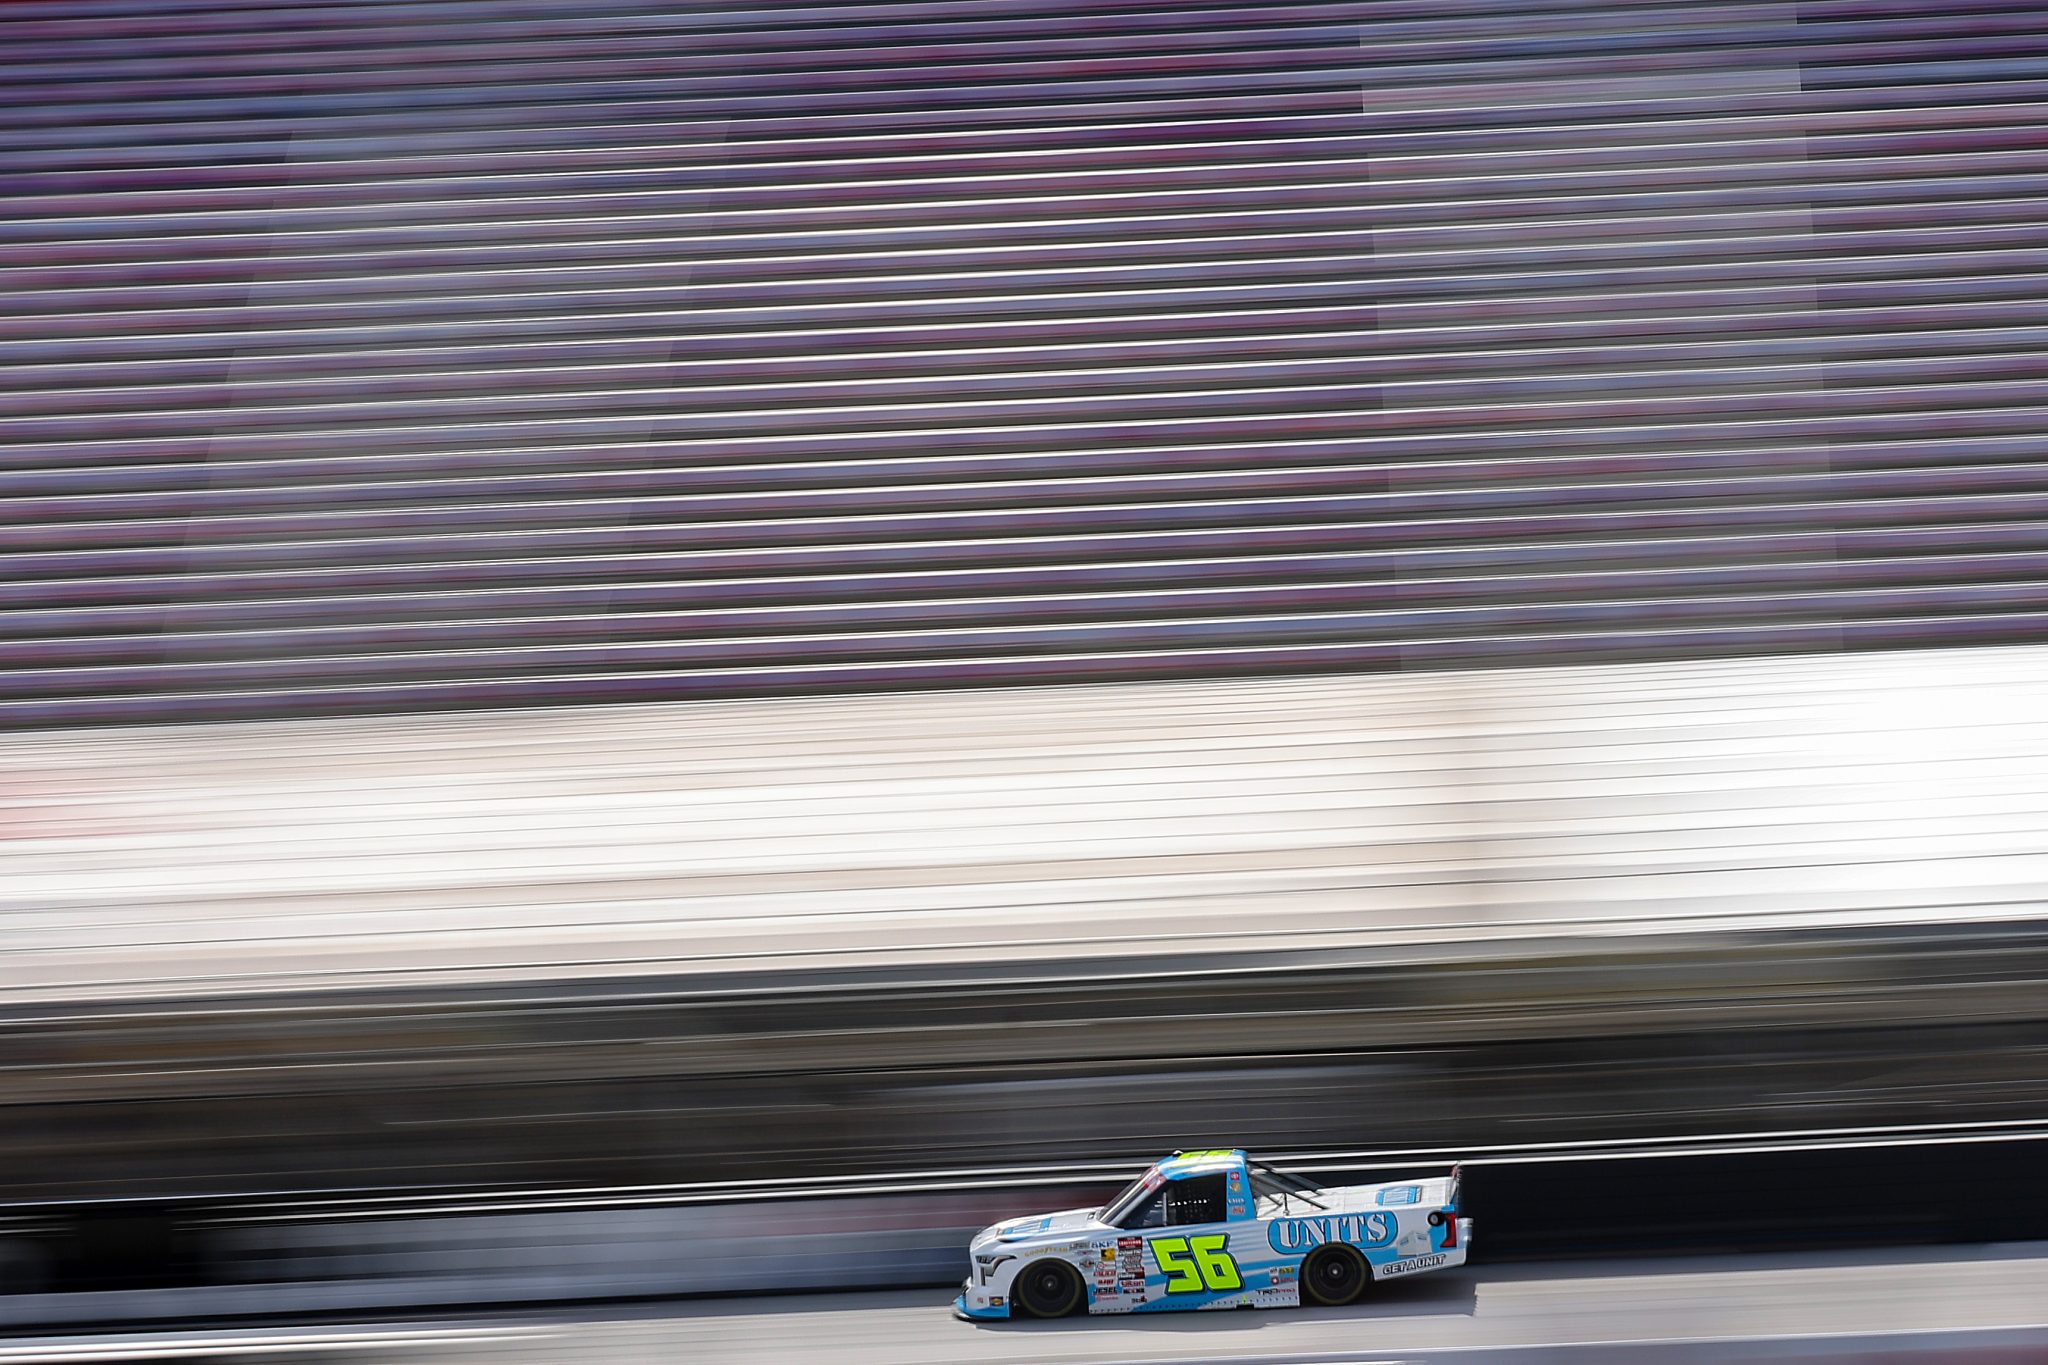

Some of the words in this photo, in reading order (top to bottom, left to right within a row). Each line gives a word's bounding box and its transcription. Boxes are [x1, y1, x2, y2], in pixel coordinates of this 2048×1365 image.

[1091, 1240, 1113, 1248] SKF
[1278, 1213, 1388, 1248] UNITS
[1149, 1234, 1243, 1294] 56
